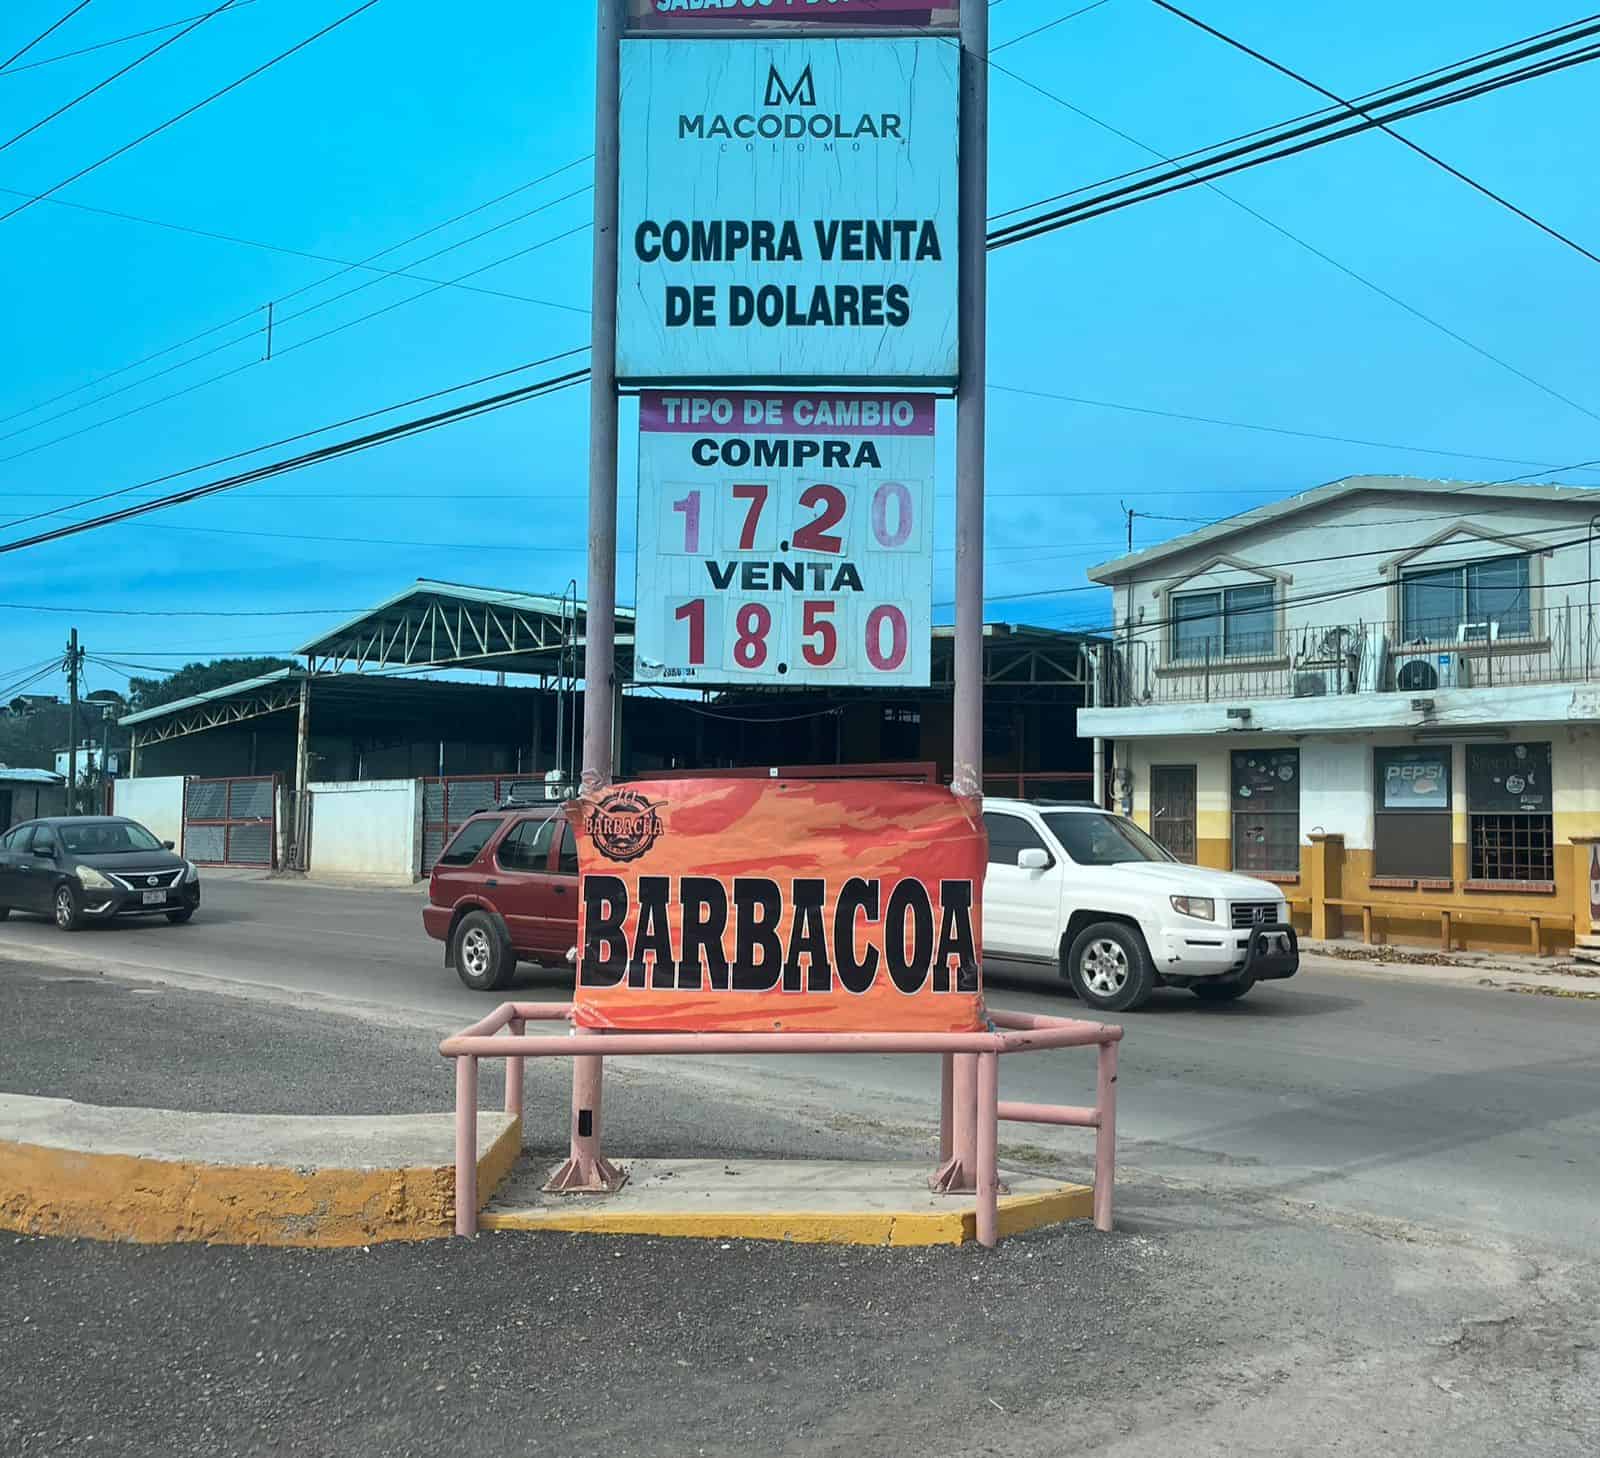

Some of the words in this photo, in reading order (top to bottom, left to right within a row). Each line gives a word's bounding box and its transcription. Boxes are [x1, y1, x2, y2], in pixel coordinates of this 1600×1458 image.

[678, 114, 902, 140] MACODOLAR
[719, 143, 861, 153] COLOMO
[634, 219, 803, 263] COMPRA
[813, 219, 943, 262] VENTA
[665, 285, 716, 327] DE
[729, 284, 911, 328] DOLARES
[661, 397, 733, 425] TIPO
[743, 398, 783, 425] DE
[792, 399, 915, 428] CAMBIO
[691, 438, 882, 469] COMPRA
[704, 560, 865, 592] VENTA
[1386, 765, 1443, 781] PEPSI
[579, 873, 983, 995] BARBACOA
